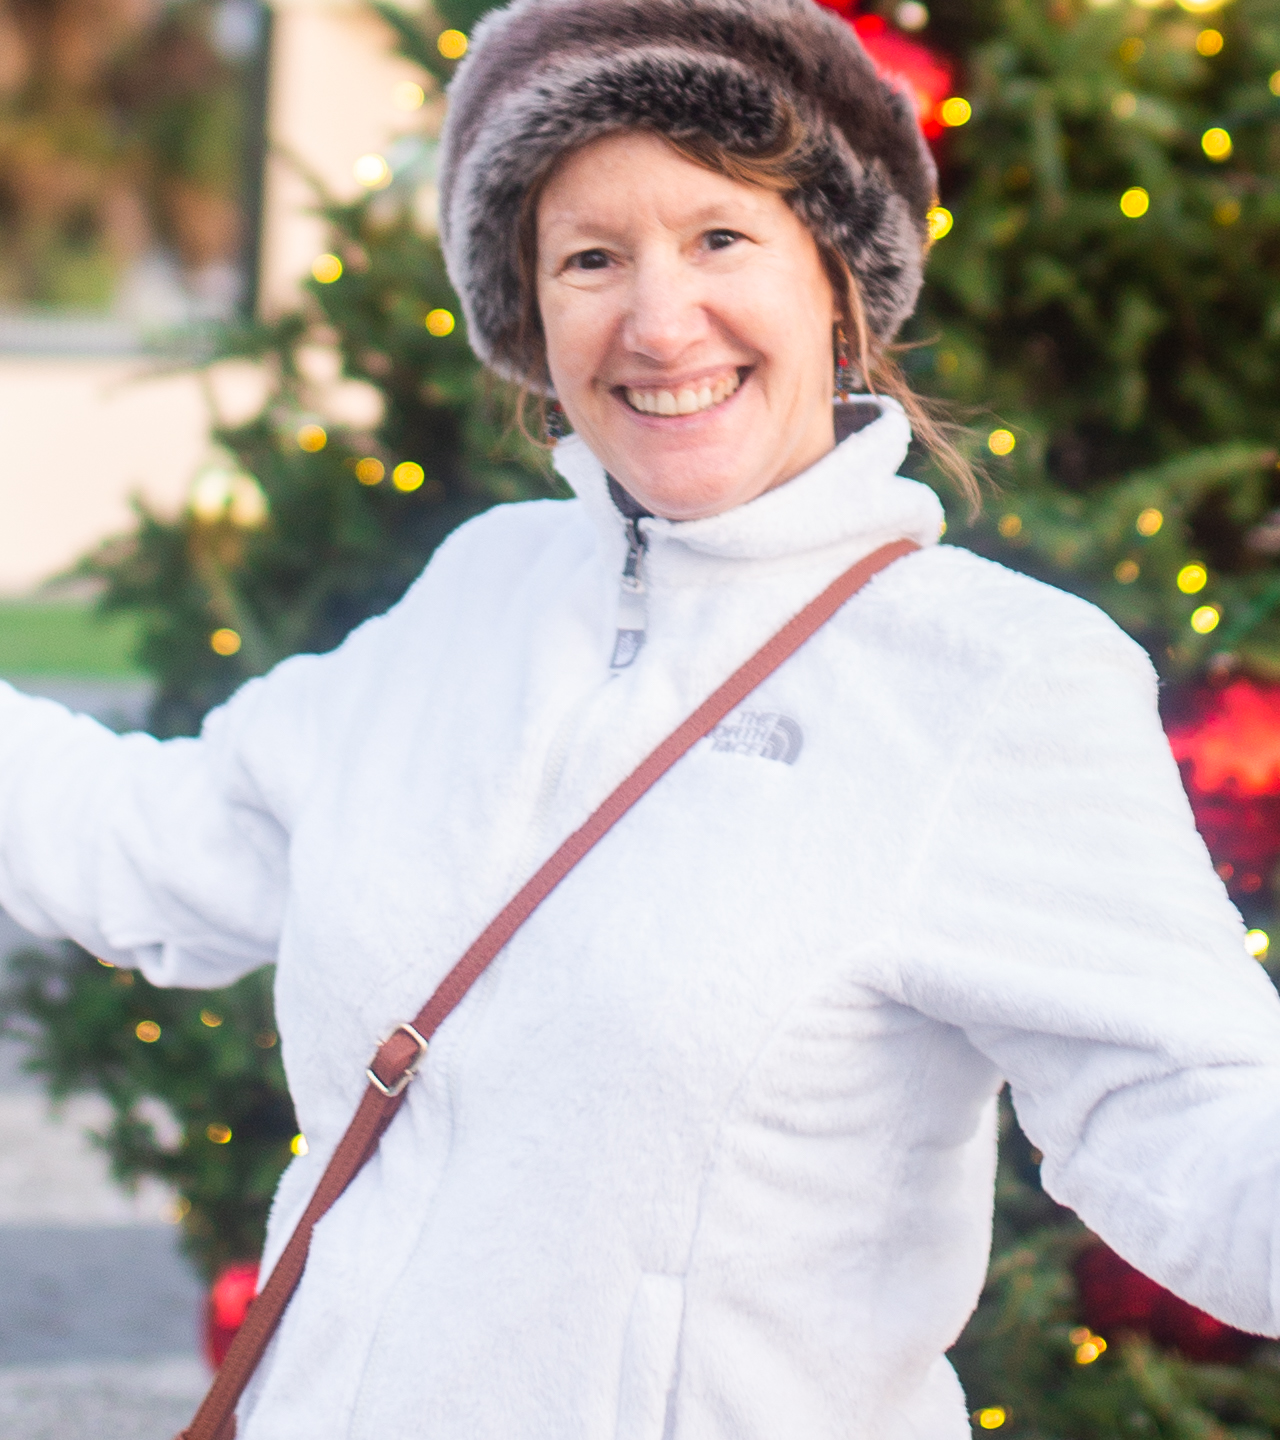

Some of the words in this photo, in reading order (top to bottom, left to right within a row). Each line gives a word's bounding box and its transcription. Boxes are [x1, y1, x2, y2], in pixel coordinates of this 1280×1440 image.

[739, 711, 773, 727] THE
[710, 724, 768, 741] ORTH
[711, 738, 759, 756] FACE
